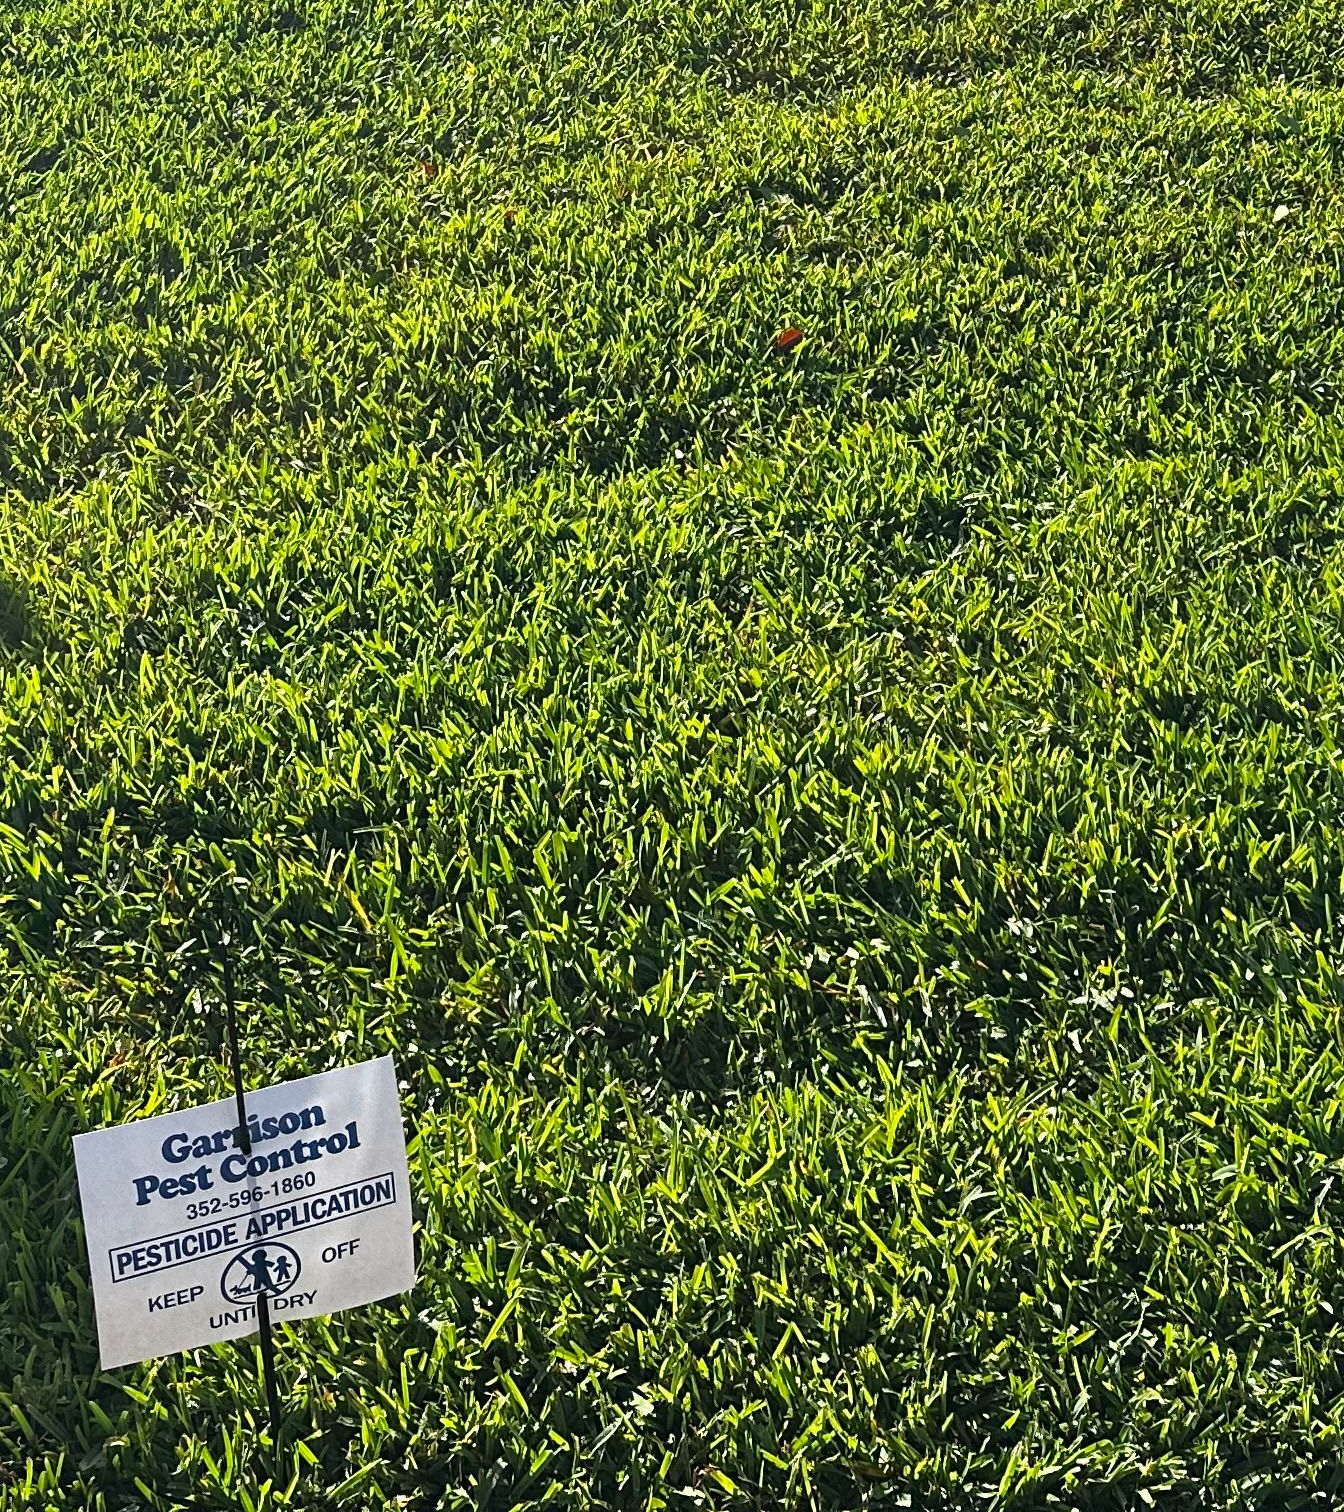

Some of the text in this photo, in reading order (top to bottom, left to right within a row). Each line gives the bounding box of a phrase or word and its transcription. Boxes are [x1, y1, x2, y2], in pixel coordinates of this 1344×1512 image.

[132, 1121, 361, 1206] Pest Control
[186, 1171, 316, 1220] 352-596-1860
[116, 1178, 392, 1276] PESTICIDE APPLICATION
[148, 1238, 361, 1313] KEEP OFF
[209, 1289, 318, 1329] UNTI DRY
